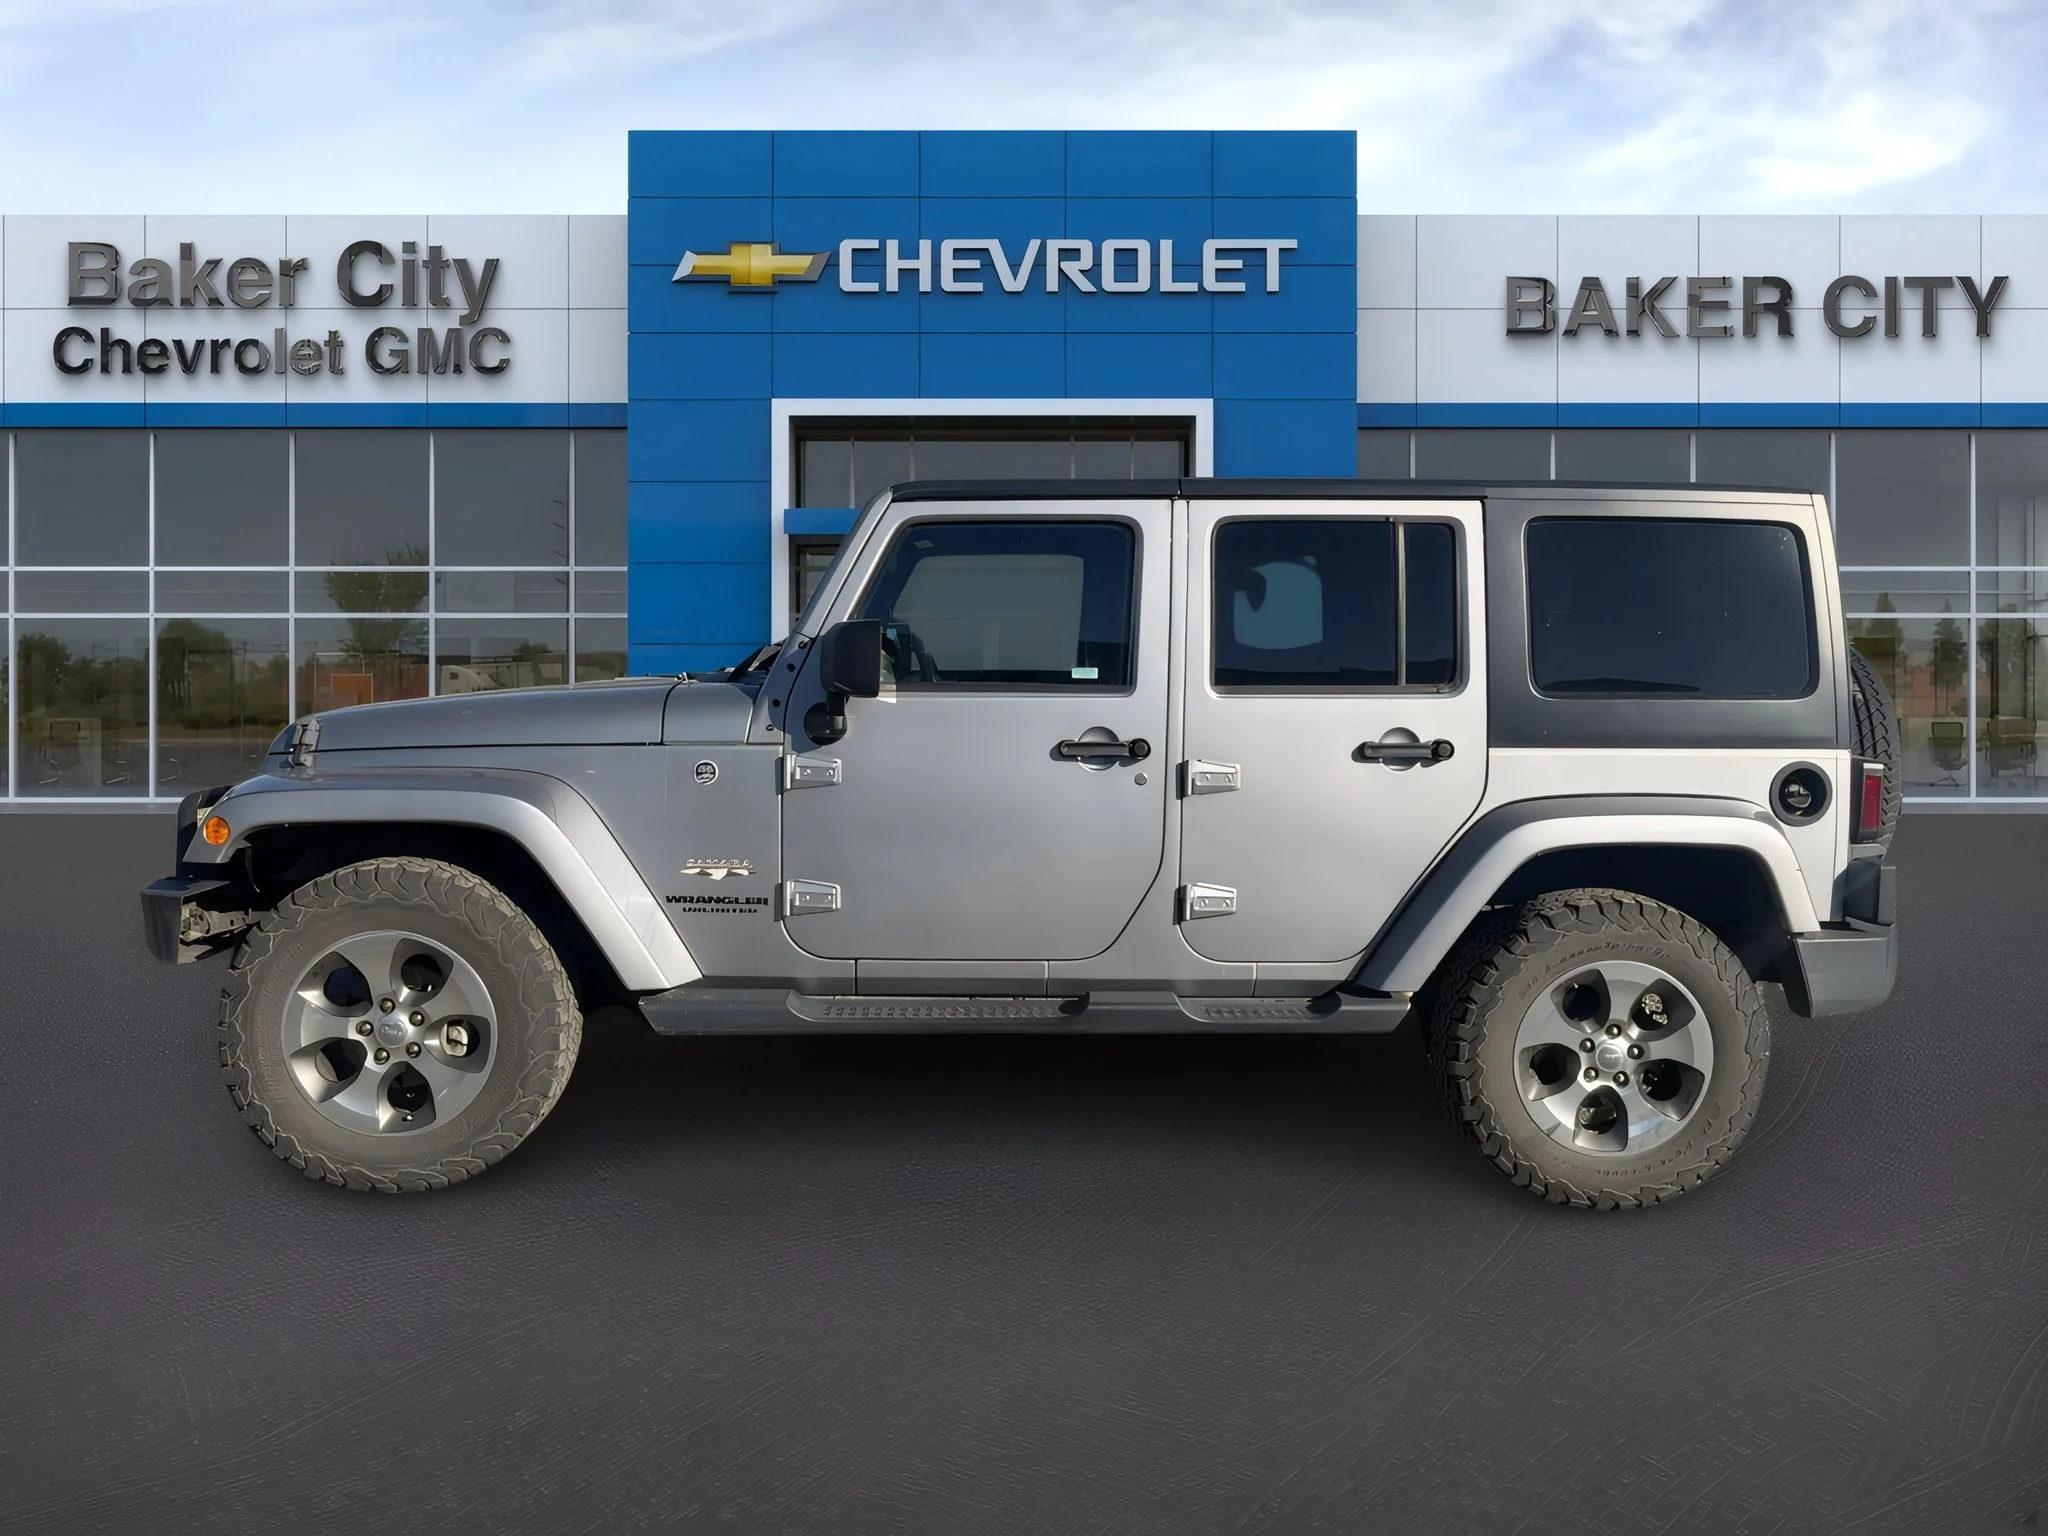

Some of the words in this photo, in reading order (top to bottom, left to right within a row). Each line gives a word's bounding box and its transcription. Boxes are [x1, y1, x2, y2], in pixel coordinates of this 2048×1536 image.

[67, 241, 308, 308] Baker
[336, 239, 500, 326] City
[838, 238, 1298, 293] CHEVROLET
[1505, 275, 1795, 339] BAKER
[1822, 274, 2010, 339] CITY
[52, 326, 346, 376] Chevrolet
[364, 326, 511, 376] GMC
[665, 895, 769, 906] WRANGLER
